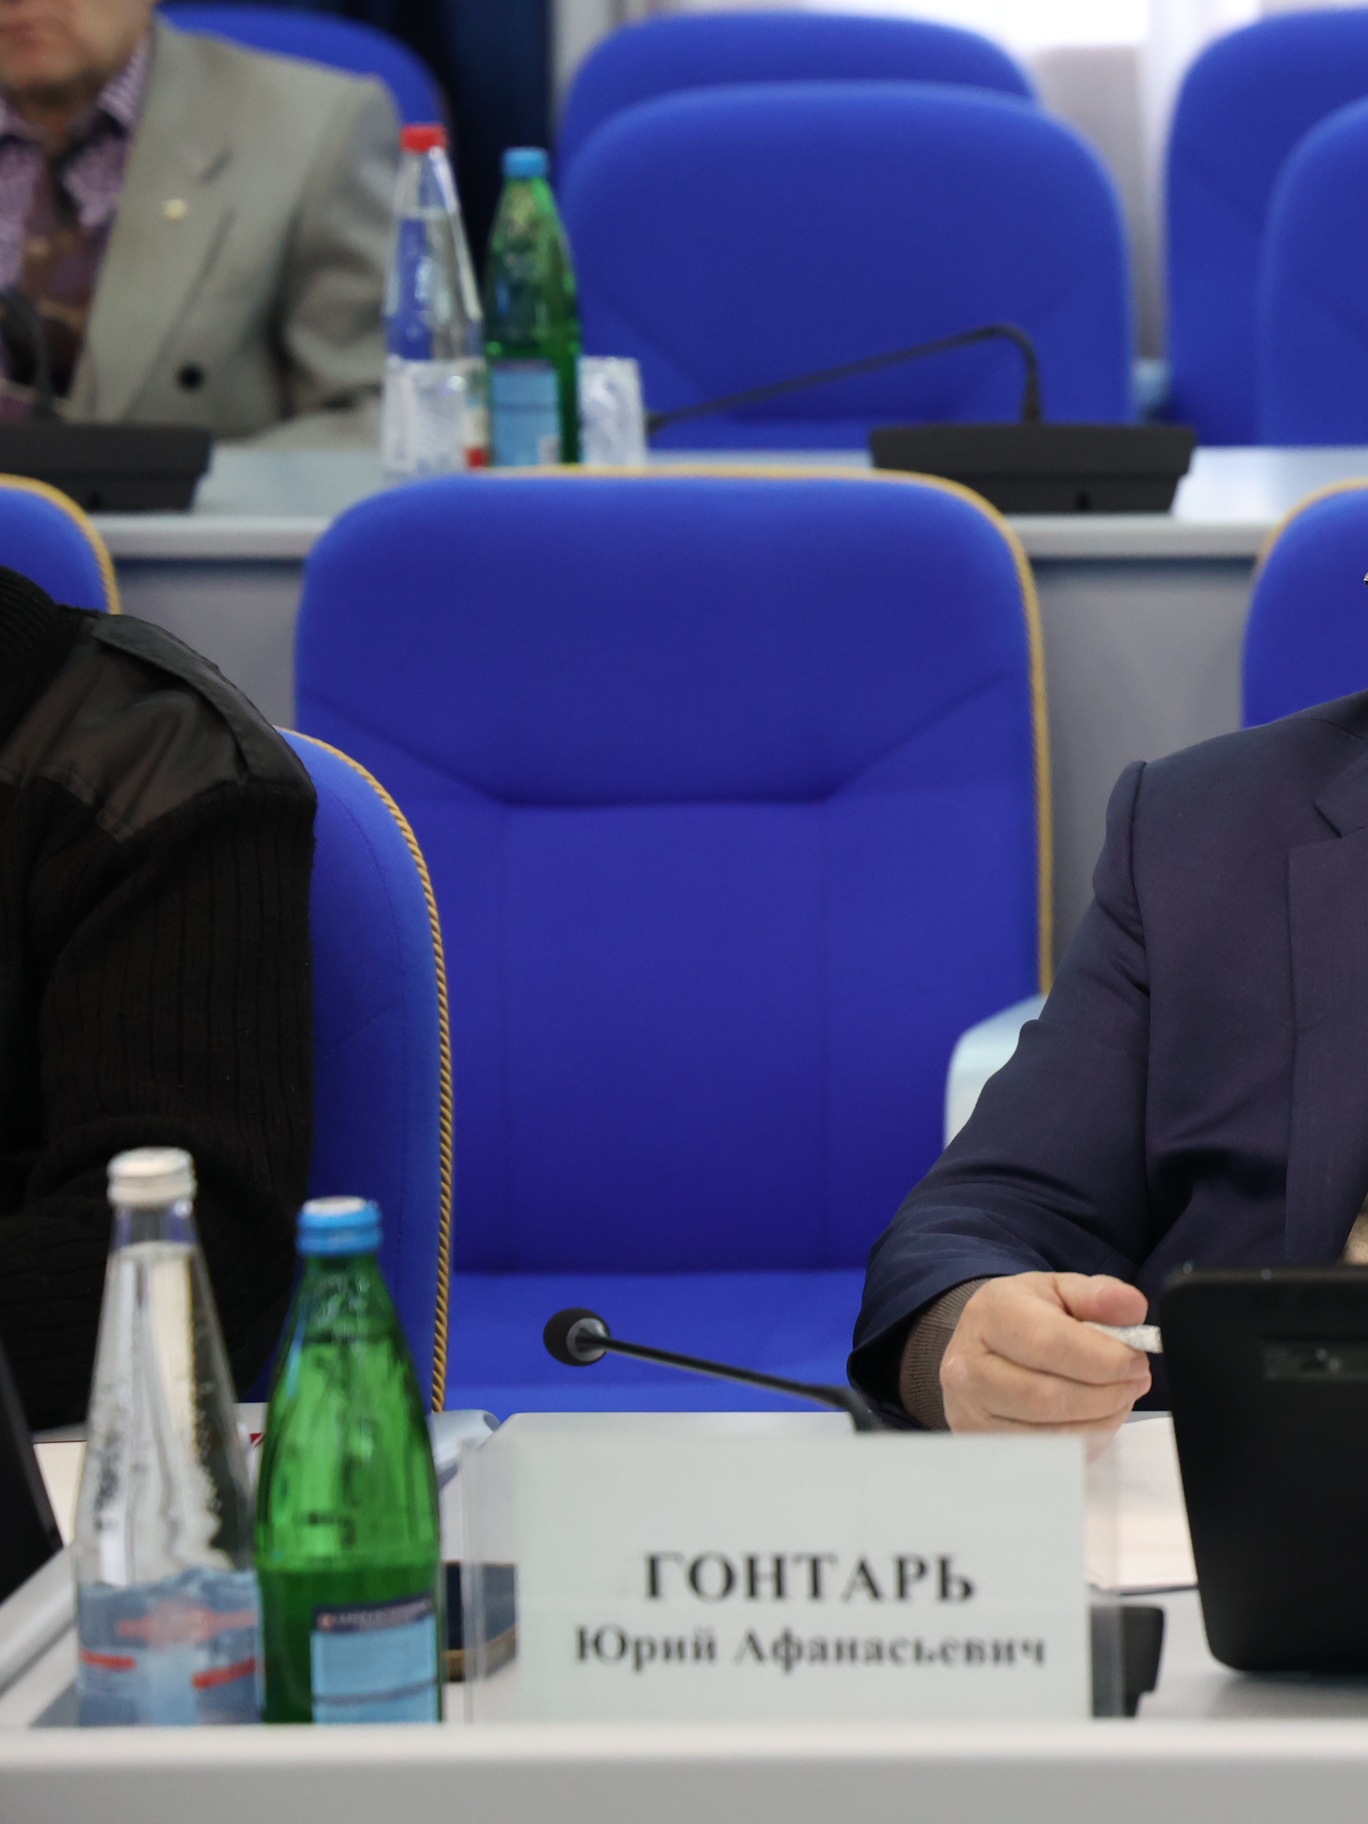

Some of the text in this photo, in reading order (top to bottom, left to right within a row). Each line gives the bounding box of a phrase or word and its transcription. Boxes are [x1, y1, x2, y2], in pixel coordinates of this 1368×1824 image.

[642, 1551, 977, 1602] ГОНТАРЬ
[573, 1622, 1047, 1675] Юрий Афанасьевич
